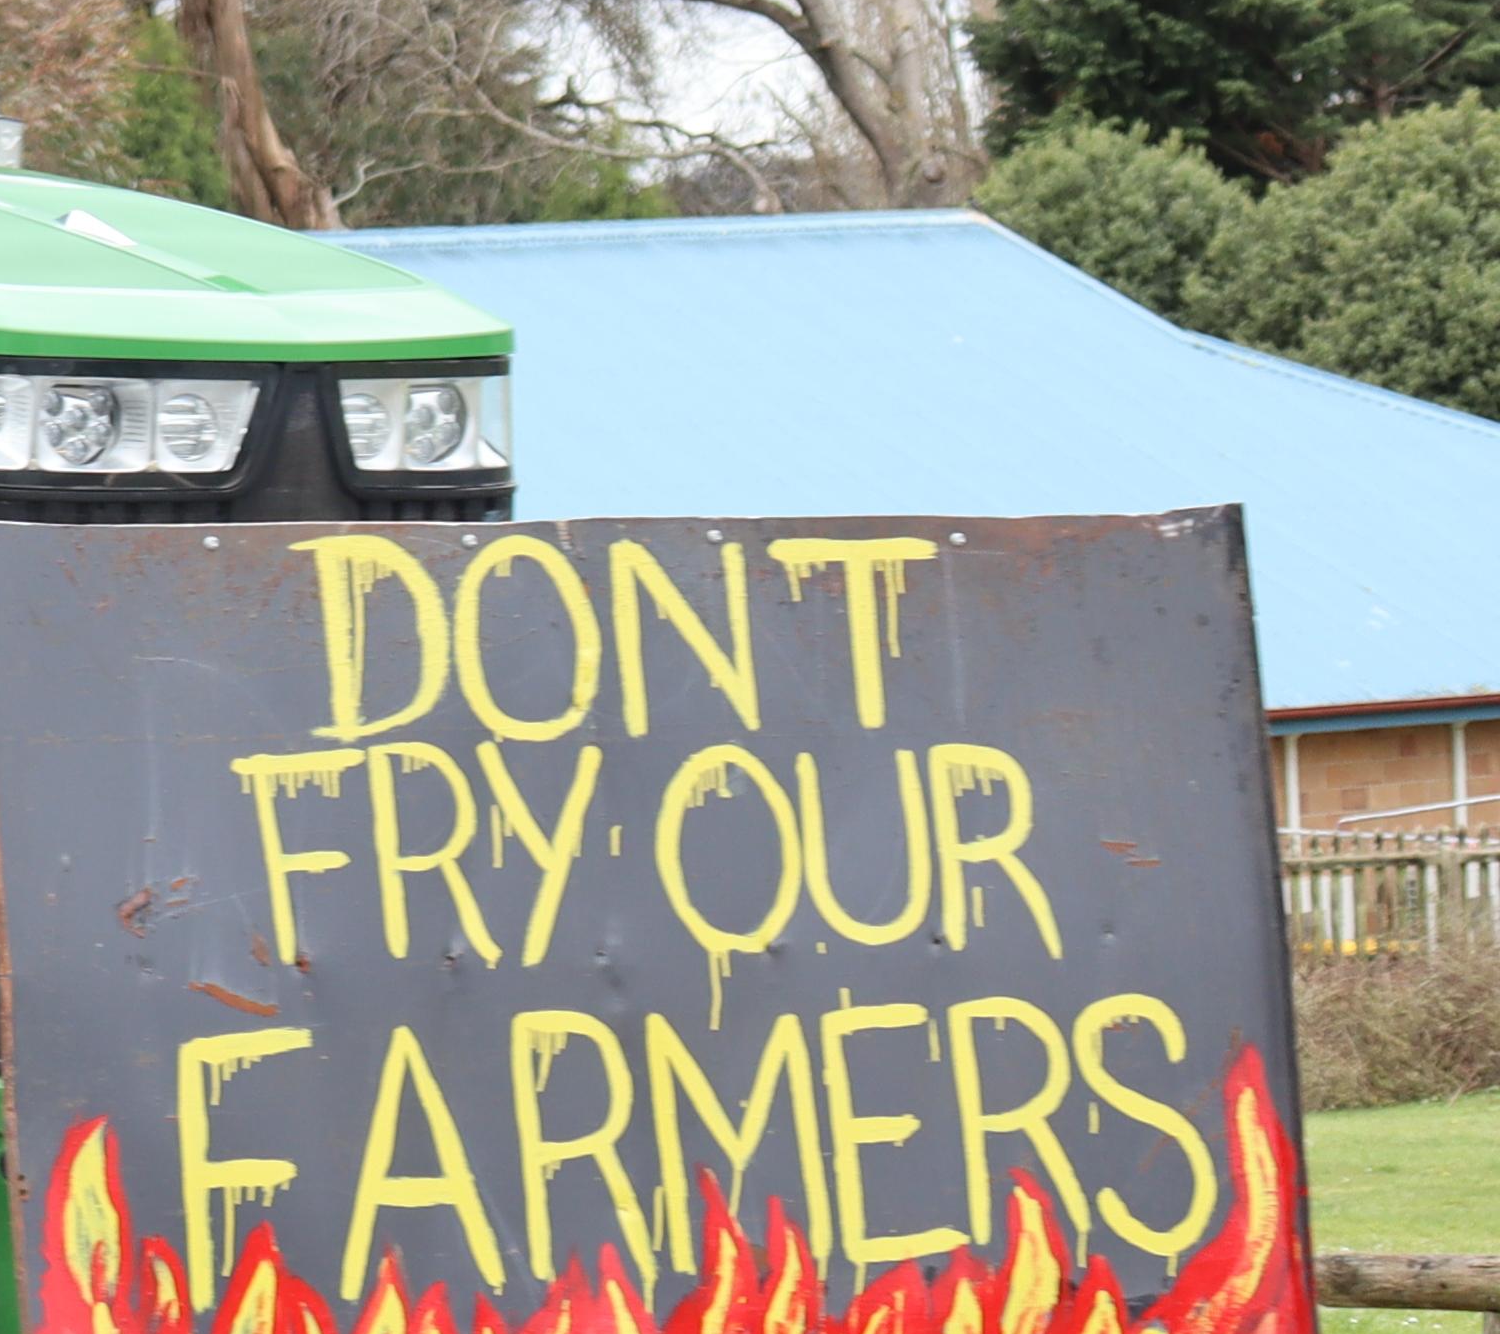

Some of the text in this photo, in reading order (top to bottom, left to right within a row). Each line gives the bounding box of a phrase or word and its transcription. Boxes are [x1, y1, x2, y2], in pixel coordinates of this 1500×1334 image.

[232, 742, 1063, 966] FRY OUR
[178, 993, 1220, 1312] FARMERS
